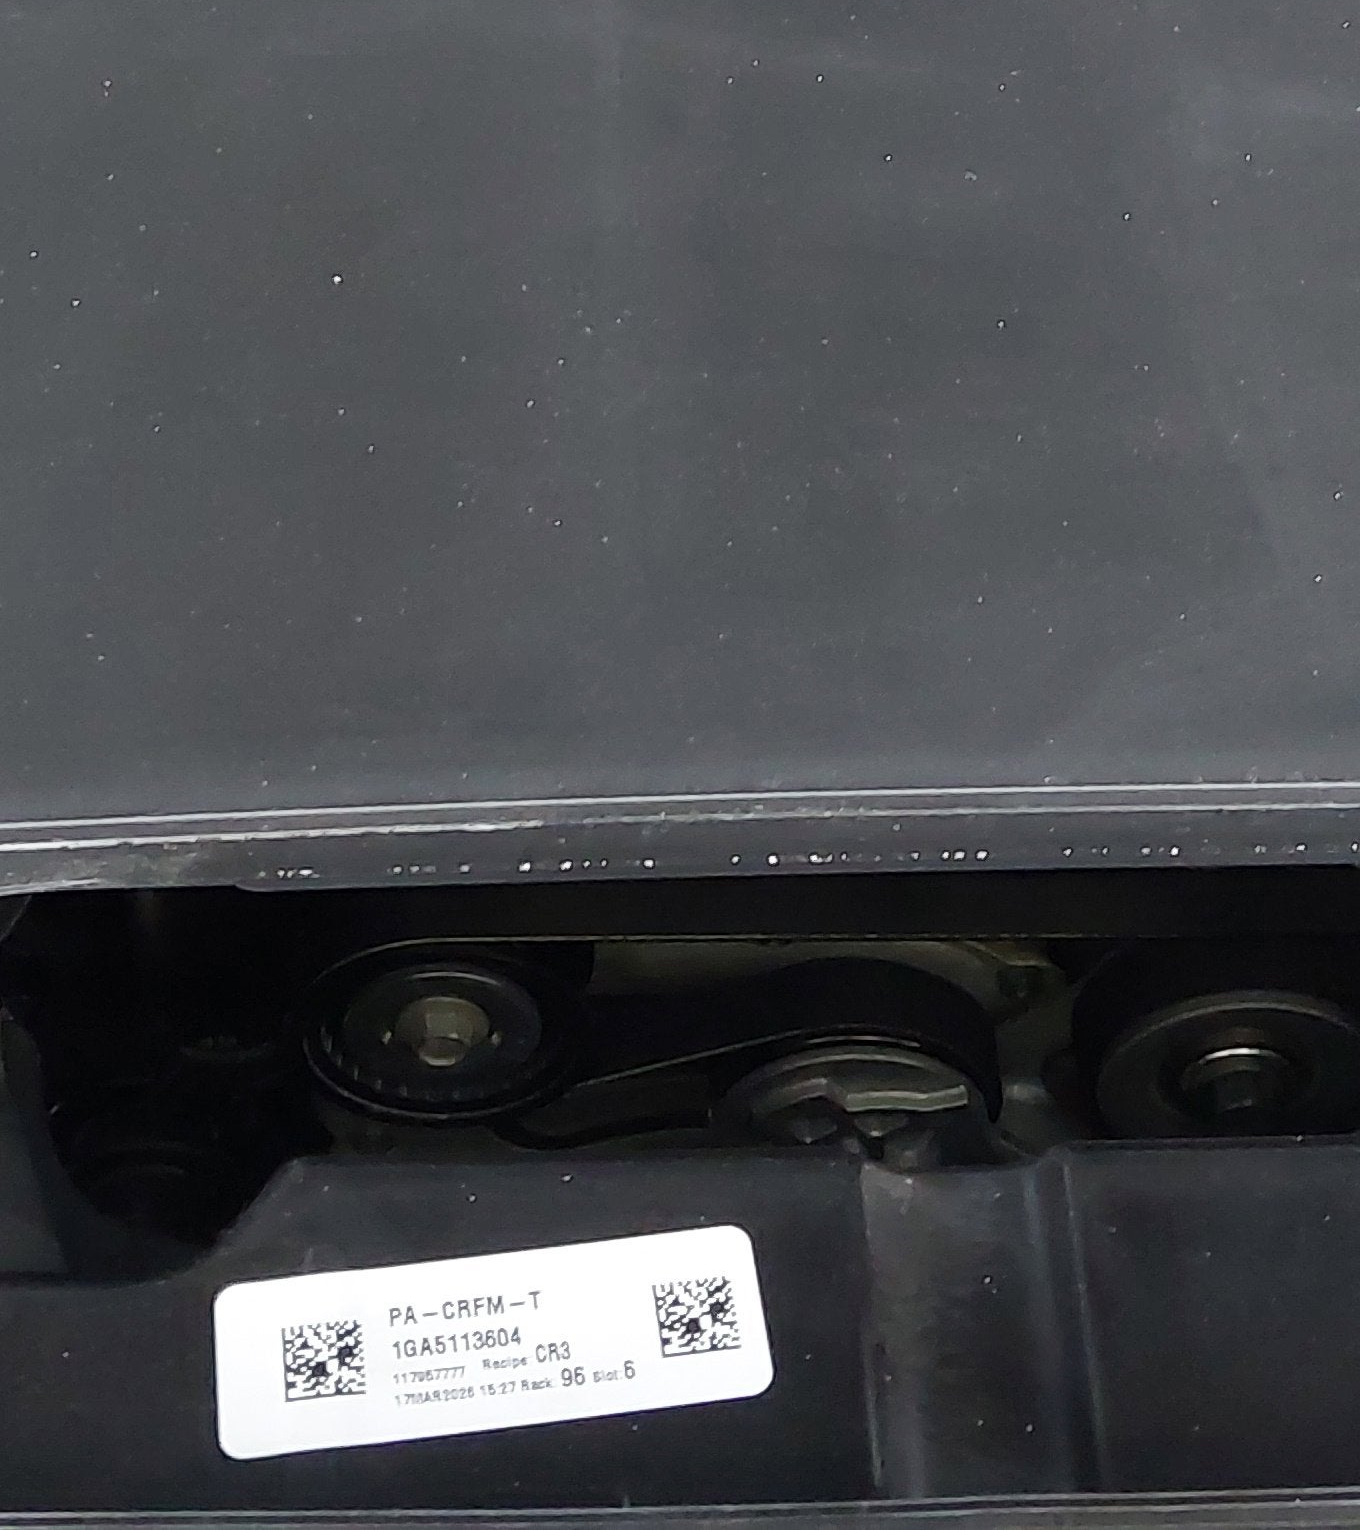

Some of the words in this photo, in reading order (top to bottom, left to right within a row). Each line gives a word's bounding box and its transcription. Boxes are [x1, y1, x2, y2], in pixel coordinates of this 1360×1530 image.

[392, 1326, 521, 1359] 1GA5113604
[536, 1341, 571, 1363] CR3
[560, 1366, 586, 1387] 96
[623, 1359, 636, 1379] 6
